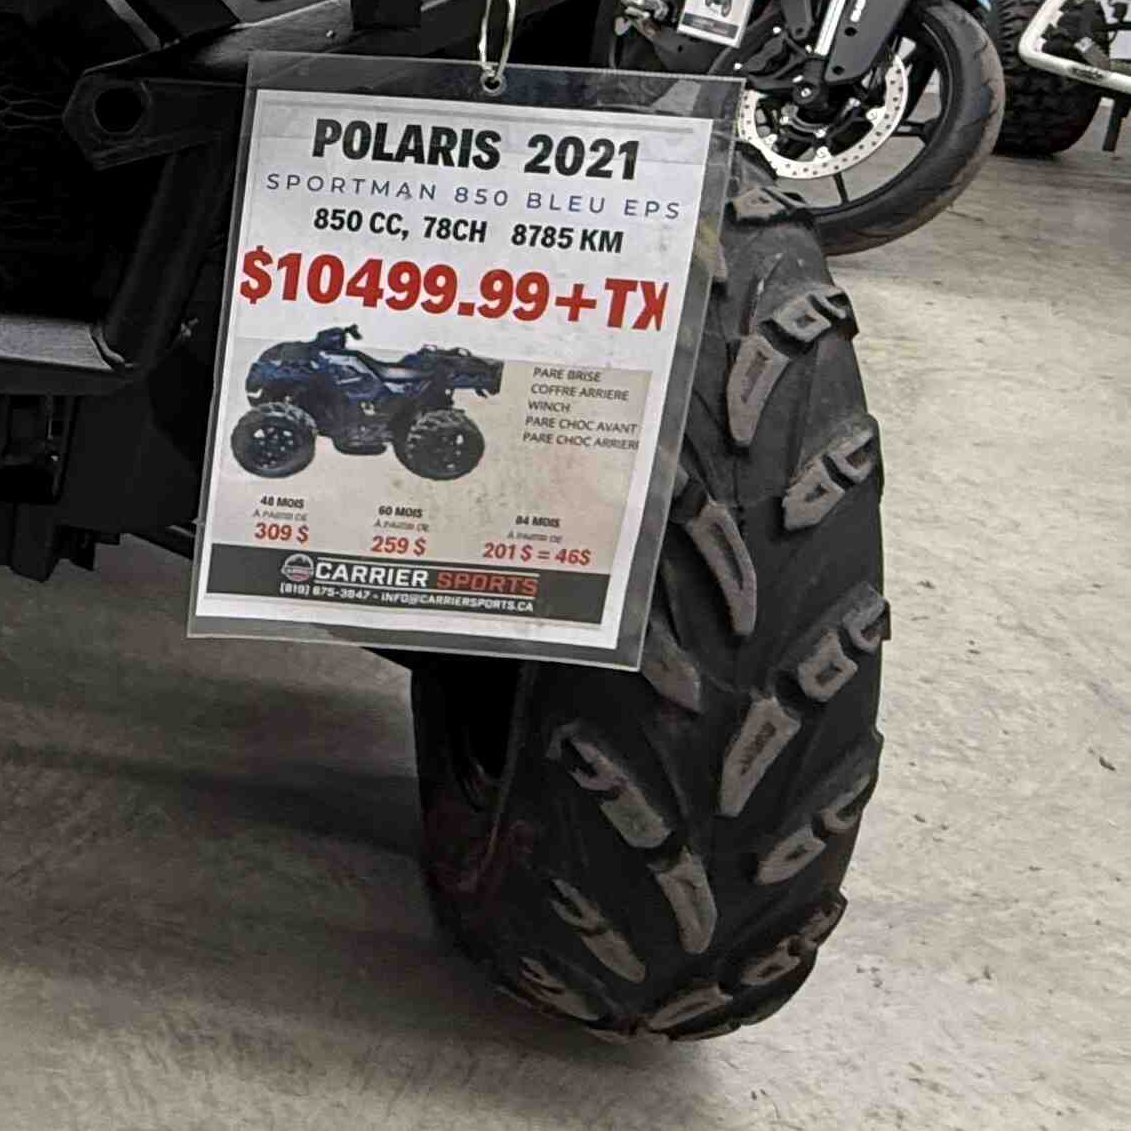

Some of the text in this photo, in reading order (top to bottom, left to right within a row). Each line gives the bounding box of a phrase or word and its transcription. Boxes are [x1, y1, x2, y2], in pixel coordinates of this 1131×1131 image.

[312, 118, 639, 180] POLARIS 2021
[266, 172, 680, 220] SPORTMAN 850 BLEU EPS
[313, 207, 624, 254] 850 CC, 78CH 8785 KM
[239, 244, 669, 332] $10499.99+TX
[532, 366, 602, 383] PARE BRISE
[530, 382, 577, 398] COFFRE
[527, 398, 571, 413] WINCH
[525, 415, 638, 435] PARE CHOC AVANT
[522, 431, 554, 445] PARE
[555, 434, 593, 447] CHOC
[276, 496, 305, 510] MOIS
[378, 504, 424, 519] 60 MOIS
[254, 522, 309, 545] 309 $
[370, 535, 427, 557] 259 $
[483, 541, 517, 560] 201
[519, 544, 533, 563] $
[554, 548, 592, 567] 46$
[315, 561, 539, 597] CARRIER SPORTS
